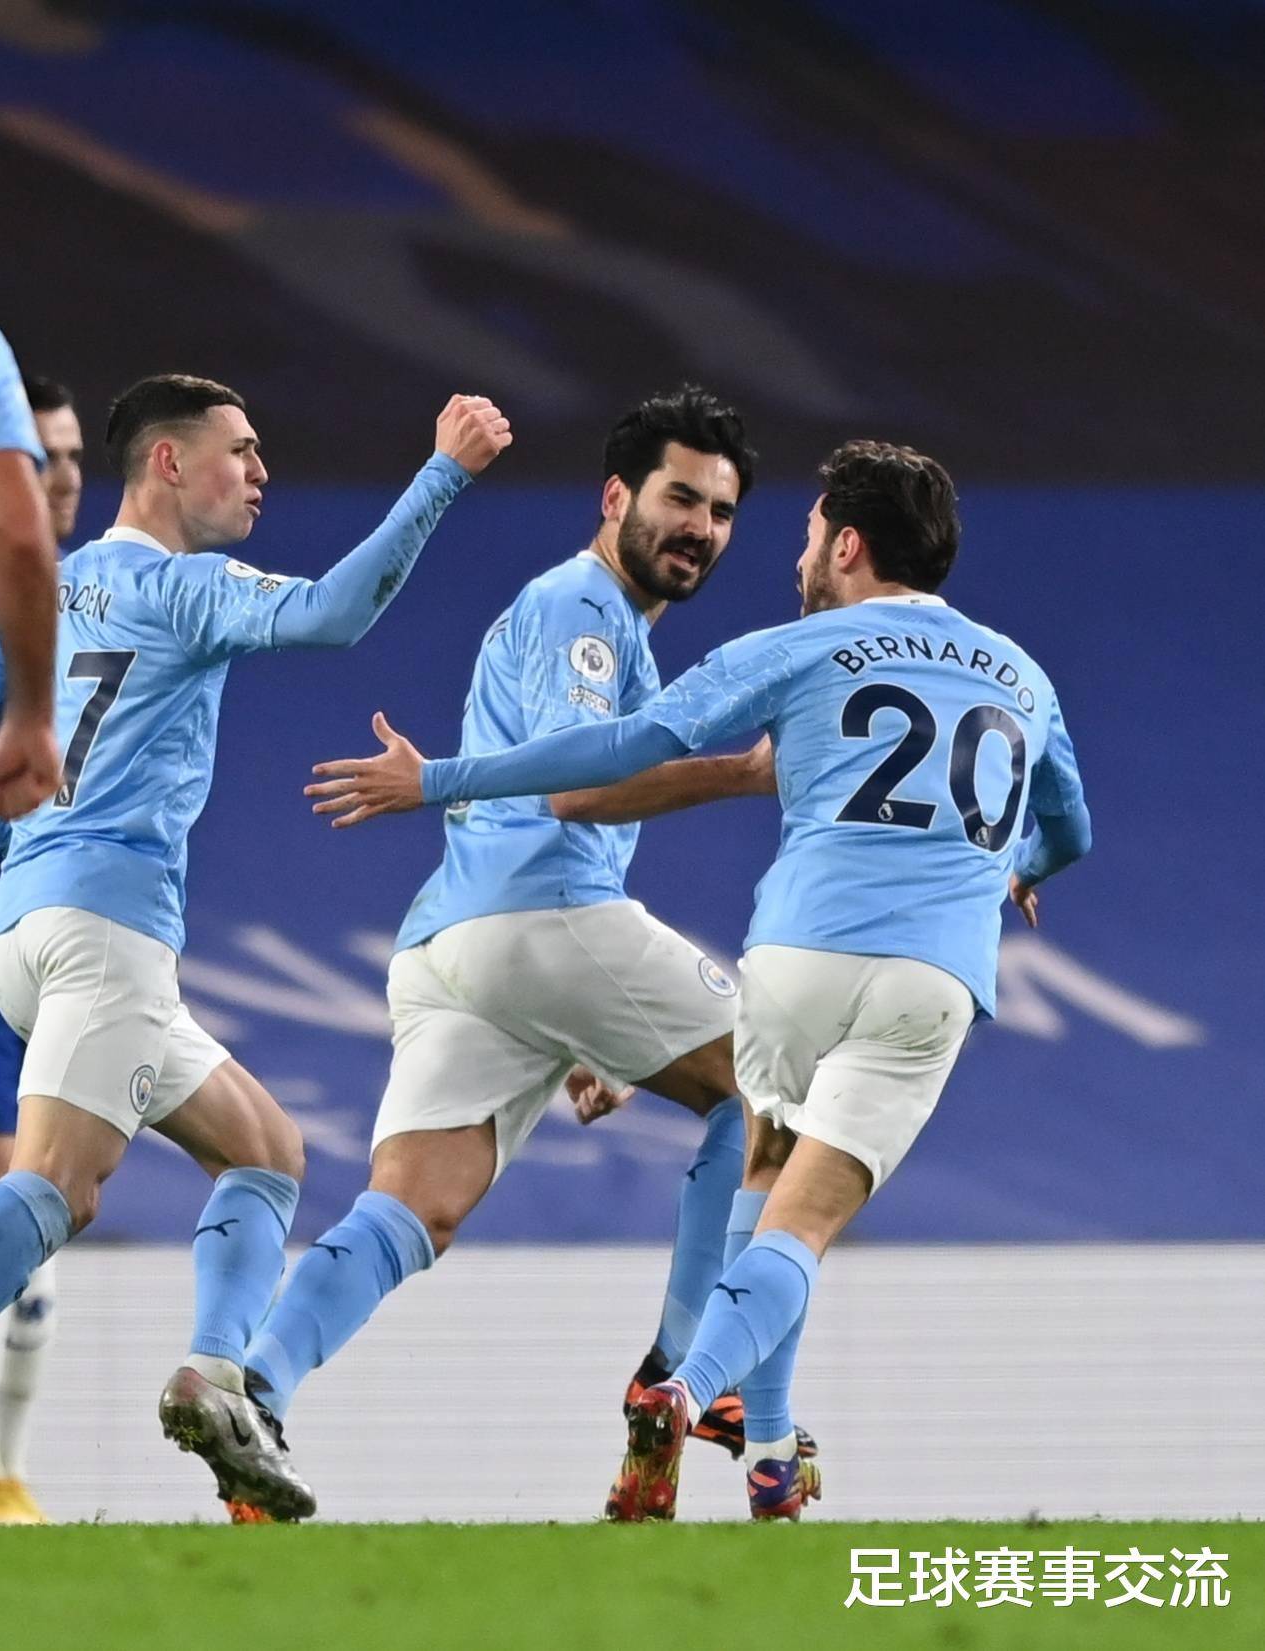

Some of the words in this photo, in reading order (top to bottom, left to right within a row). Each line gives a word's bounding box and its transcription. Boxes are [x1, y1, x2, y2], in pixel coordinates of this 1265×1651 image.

[56, 583, 112, 625] ODEN
[52, 650, 137, 809] 7
[831, 635, 1036, 714] BERNARDO
[834, 682, 1027, 853] 20
